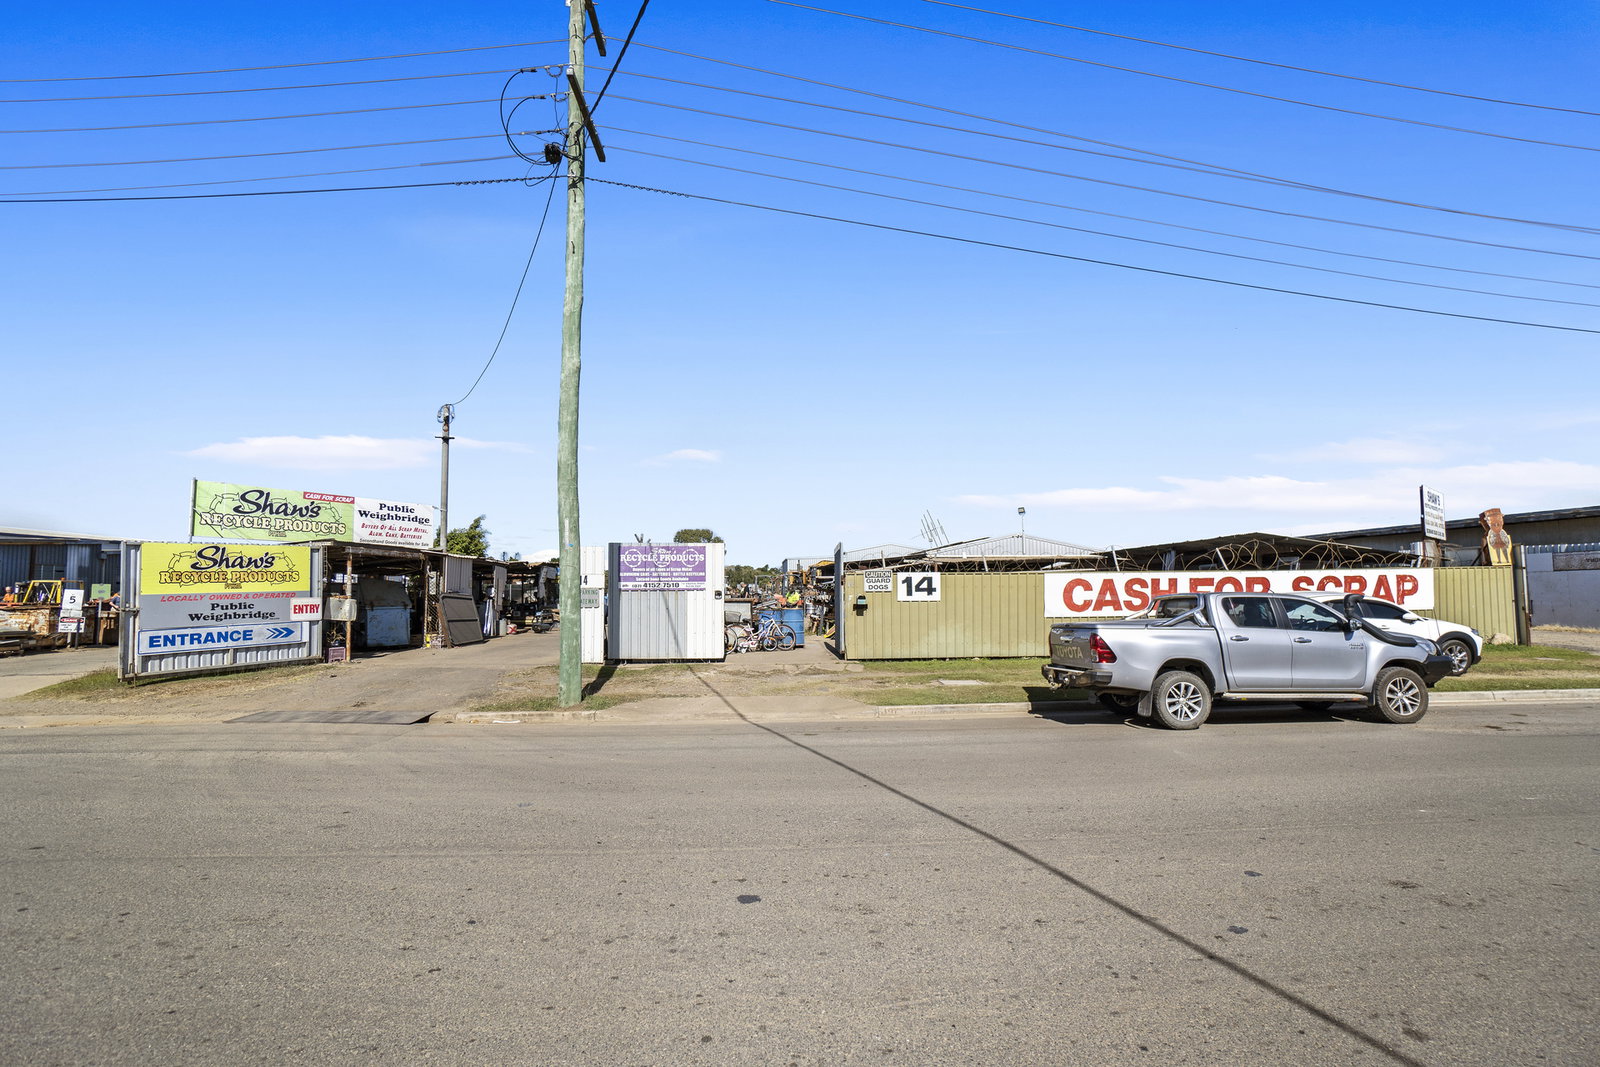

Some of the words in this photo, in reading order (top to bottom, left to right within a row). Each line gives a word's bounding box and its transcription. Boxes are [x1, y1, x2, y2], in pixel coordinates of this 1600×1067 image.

[233, 490, 321, 518] Shaw's
[379, 503, 415, 514] Public
[200, 512, 272, 529] RECYCLE
[274, 518, 346, 534] PRODUCTS
[358, 510, 430, 525] Weighbridge
[191, 546, 275, 570] Shaw's
[620, 554, 658, 562] RECYCLE
[660, 554, 705, 562] PRODUCTS
[159, 571, 228, 583] RECYCLE
[231, 571, 300, 583] PRODUCTS
[901, 576, 936, 596] 14
[161, 594, 206, 602] LOCALLY
[209, 593, 242, 601] OWNED
[252, 592, 296, 600] OPERATED
[211, 602, 254, 611] Public
[293, 604, 320, 614] ENTRY
[188, 611, 276, 622] Weighbridge
[148, 630, 254, 648] ENTRANCE
[1055, 645, 1084, 659] TOYOTA
